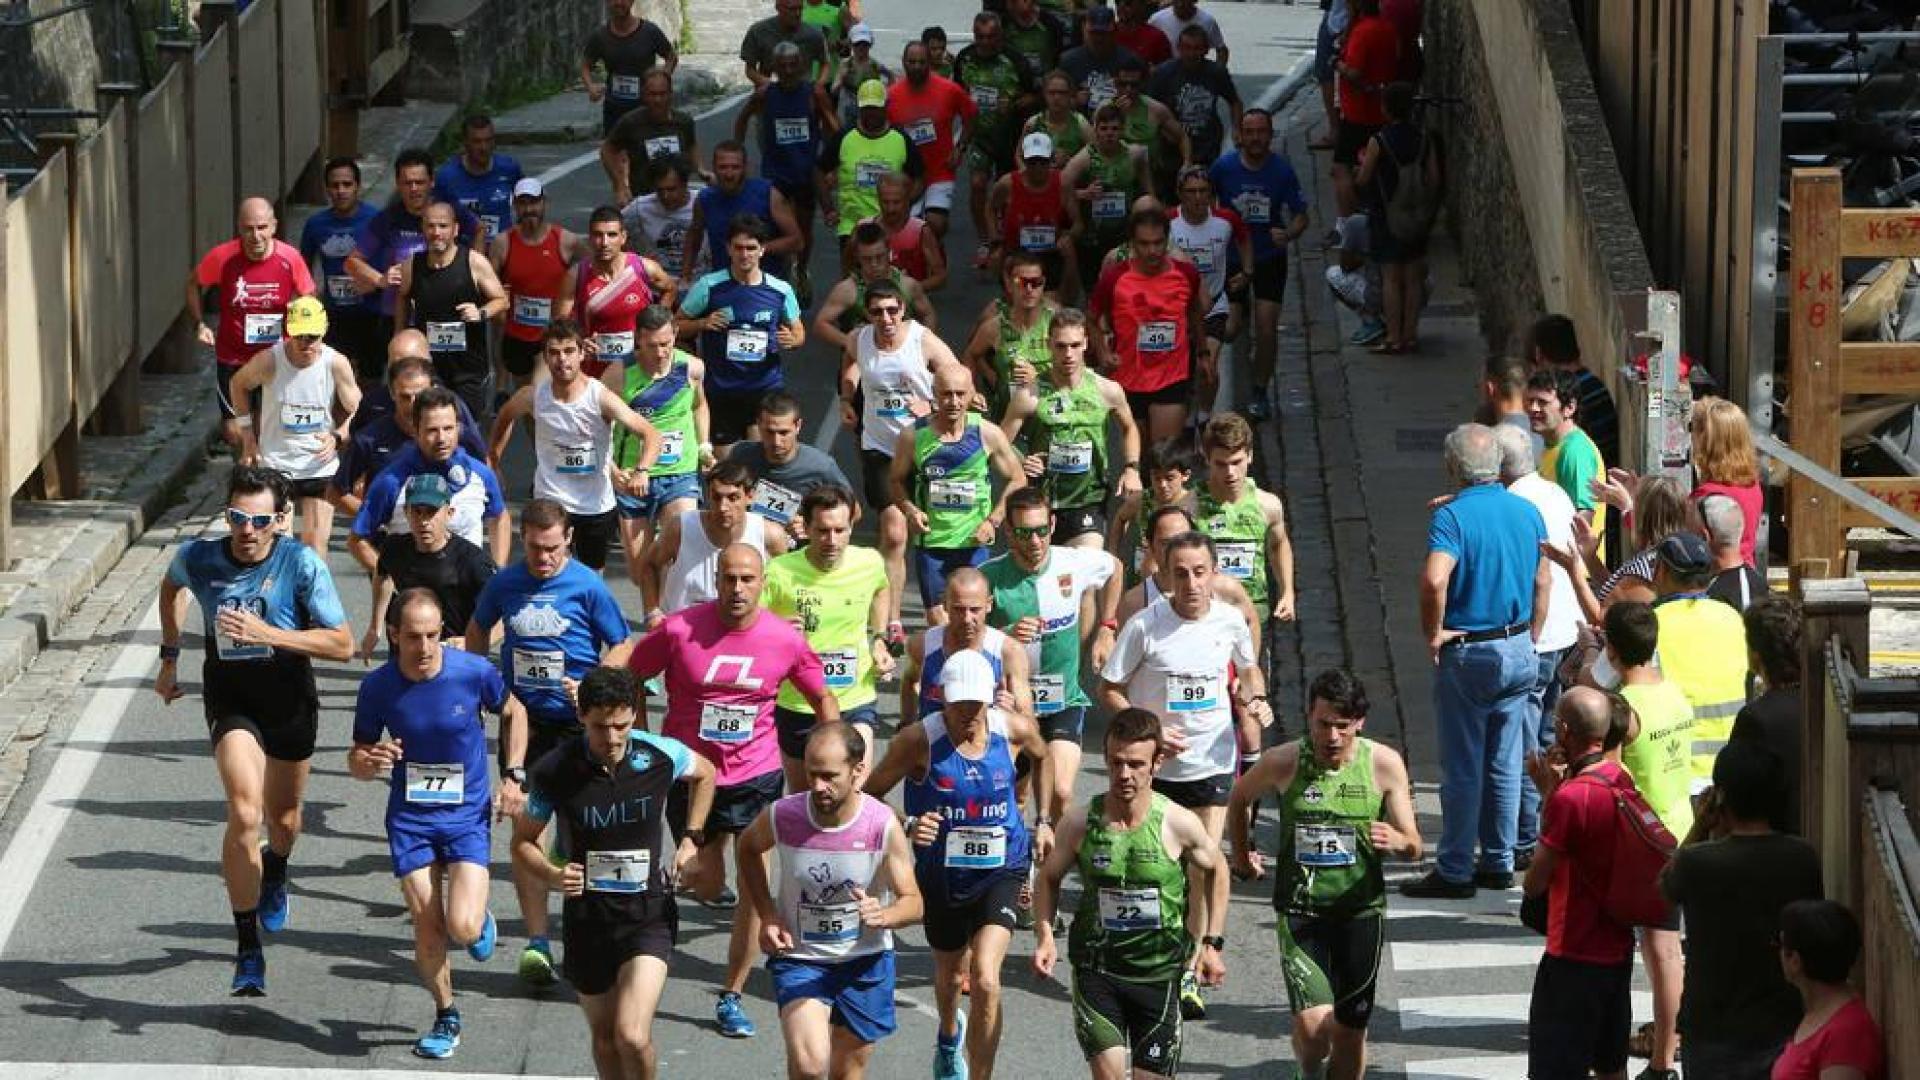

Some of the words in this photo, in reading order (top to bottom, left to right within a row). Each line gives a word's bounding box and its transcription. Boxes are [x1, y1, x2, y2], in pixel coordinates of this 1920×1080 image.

[437, 334, 453, 344] 57
[1150, 333, 1166, 343] 49
[739, 342, 755, 352] 52
[295, 414, 311, 424] 71
[565, 454, 584, 466] 86
[767, 498, 786, 513] 74
[1222, 555, 1240, 568] 34
[527, 666, 551, 680] 45
[1183, 686, 1205, 701] 99
[716, 718, 741, 732] 68
[423, 776, 447, 791] 77
[964, 842, 989, 856] 88
[1315, 841, 1337, 855] 15
[613, 868, 623, 881] 1
[1116, 906, 1142, 920] 22
[818, 920, 843, 934] 55
